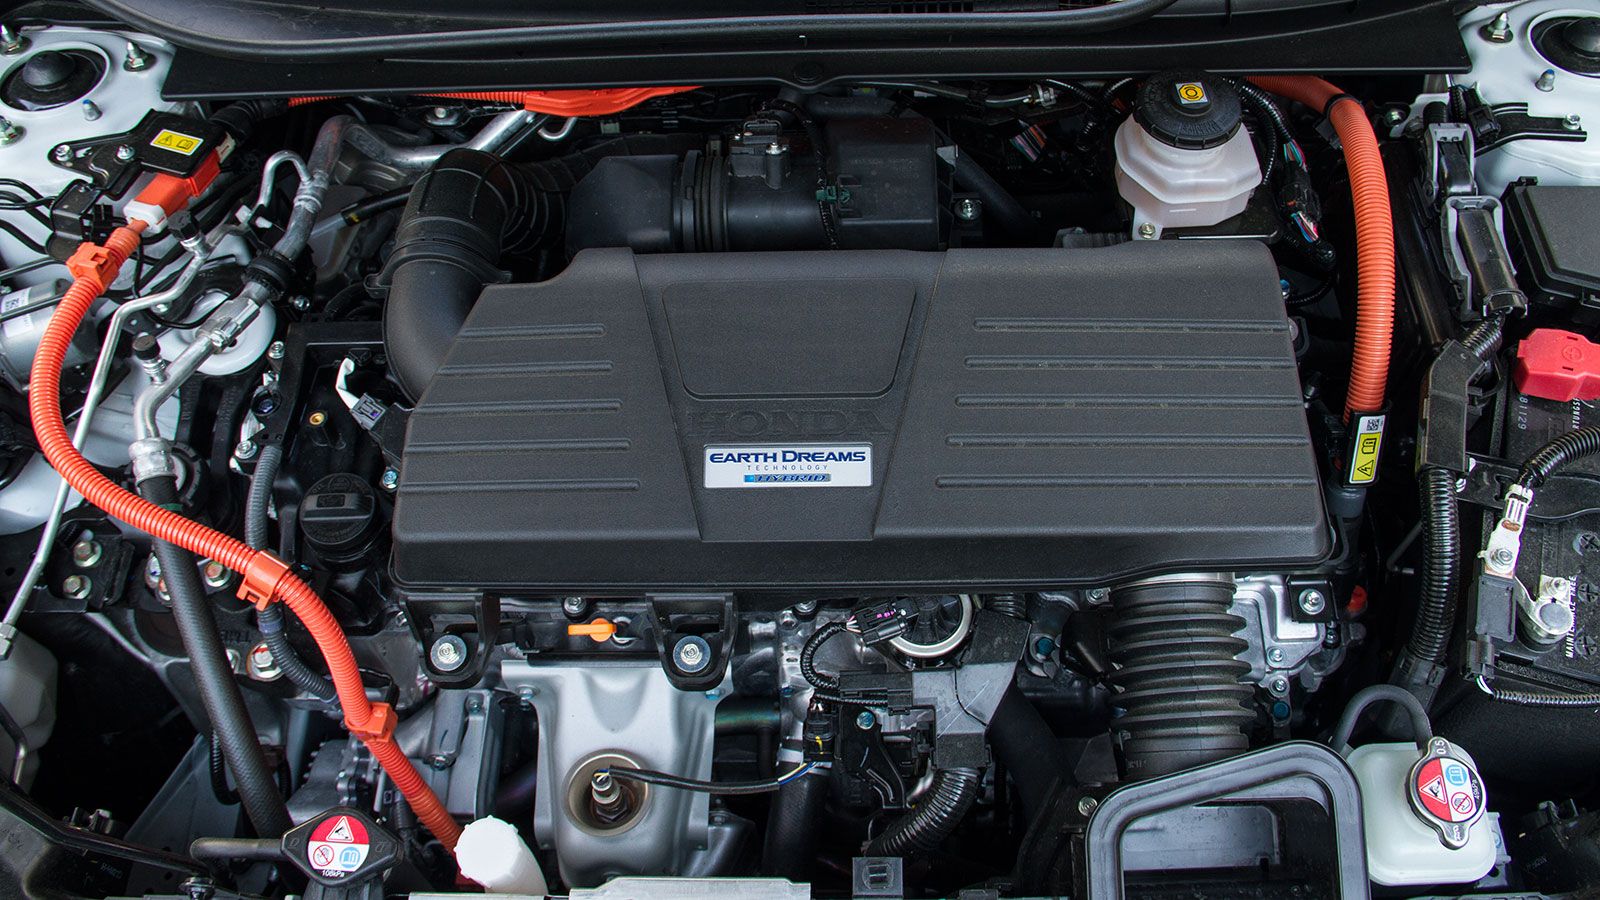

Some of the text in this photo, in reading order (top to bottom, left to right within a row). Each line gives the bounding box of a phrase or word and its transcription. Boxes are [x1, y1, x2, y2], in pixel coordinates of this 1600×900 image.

[686, 409, 891, 436] HONDA
[709, 450, 866, 463] EARTH DREAMS
[757, 473, 826, 482] HYBRID
[1566, 601, 1576, 658] MAINTECE
[1434, 740, 1447, 755] 0.5
